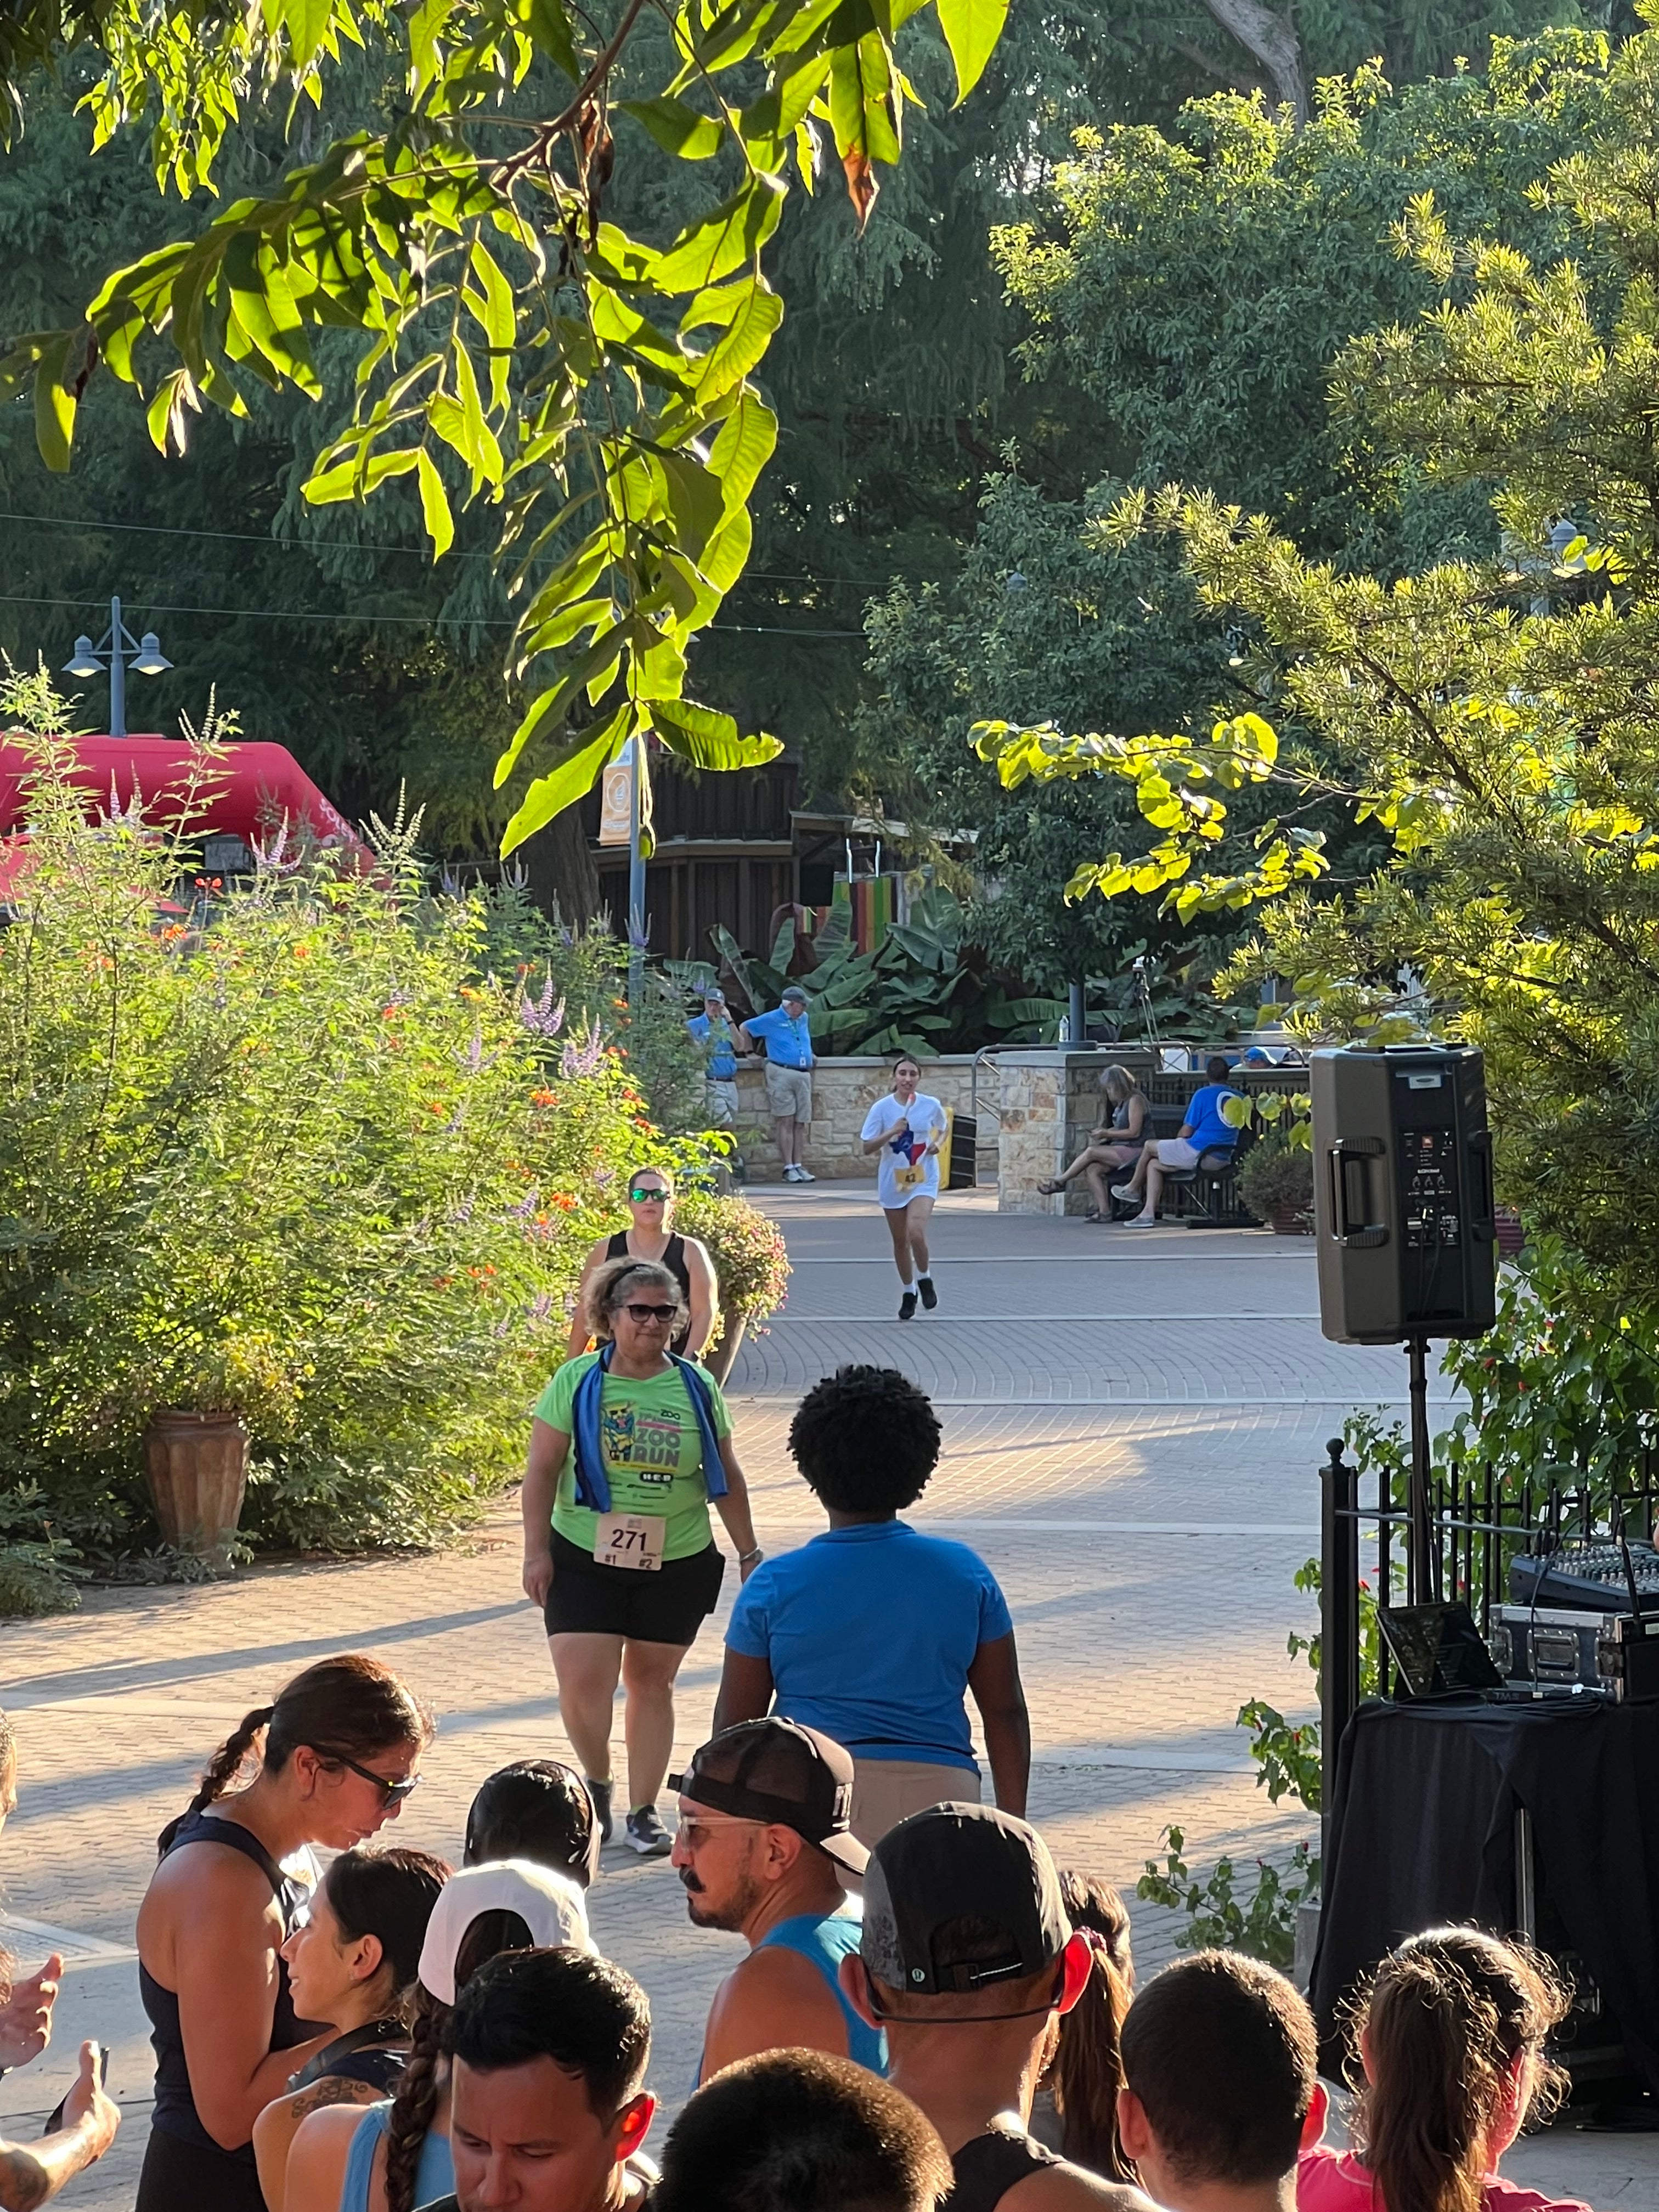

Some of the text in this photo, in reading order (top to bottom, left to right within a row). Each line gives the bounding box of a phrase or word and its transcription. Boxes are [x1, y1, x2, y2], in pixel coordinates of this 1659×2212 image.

[635, 1428, 681, 1449] ZOO
[633, 1445, 680, 1467] RUN
[611, 1529, 646, 1551] 271
